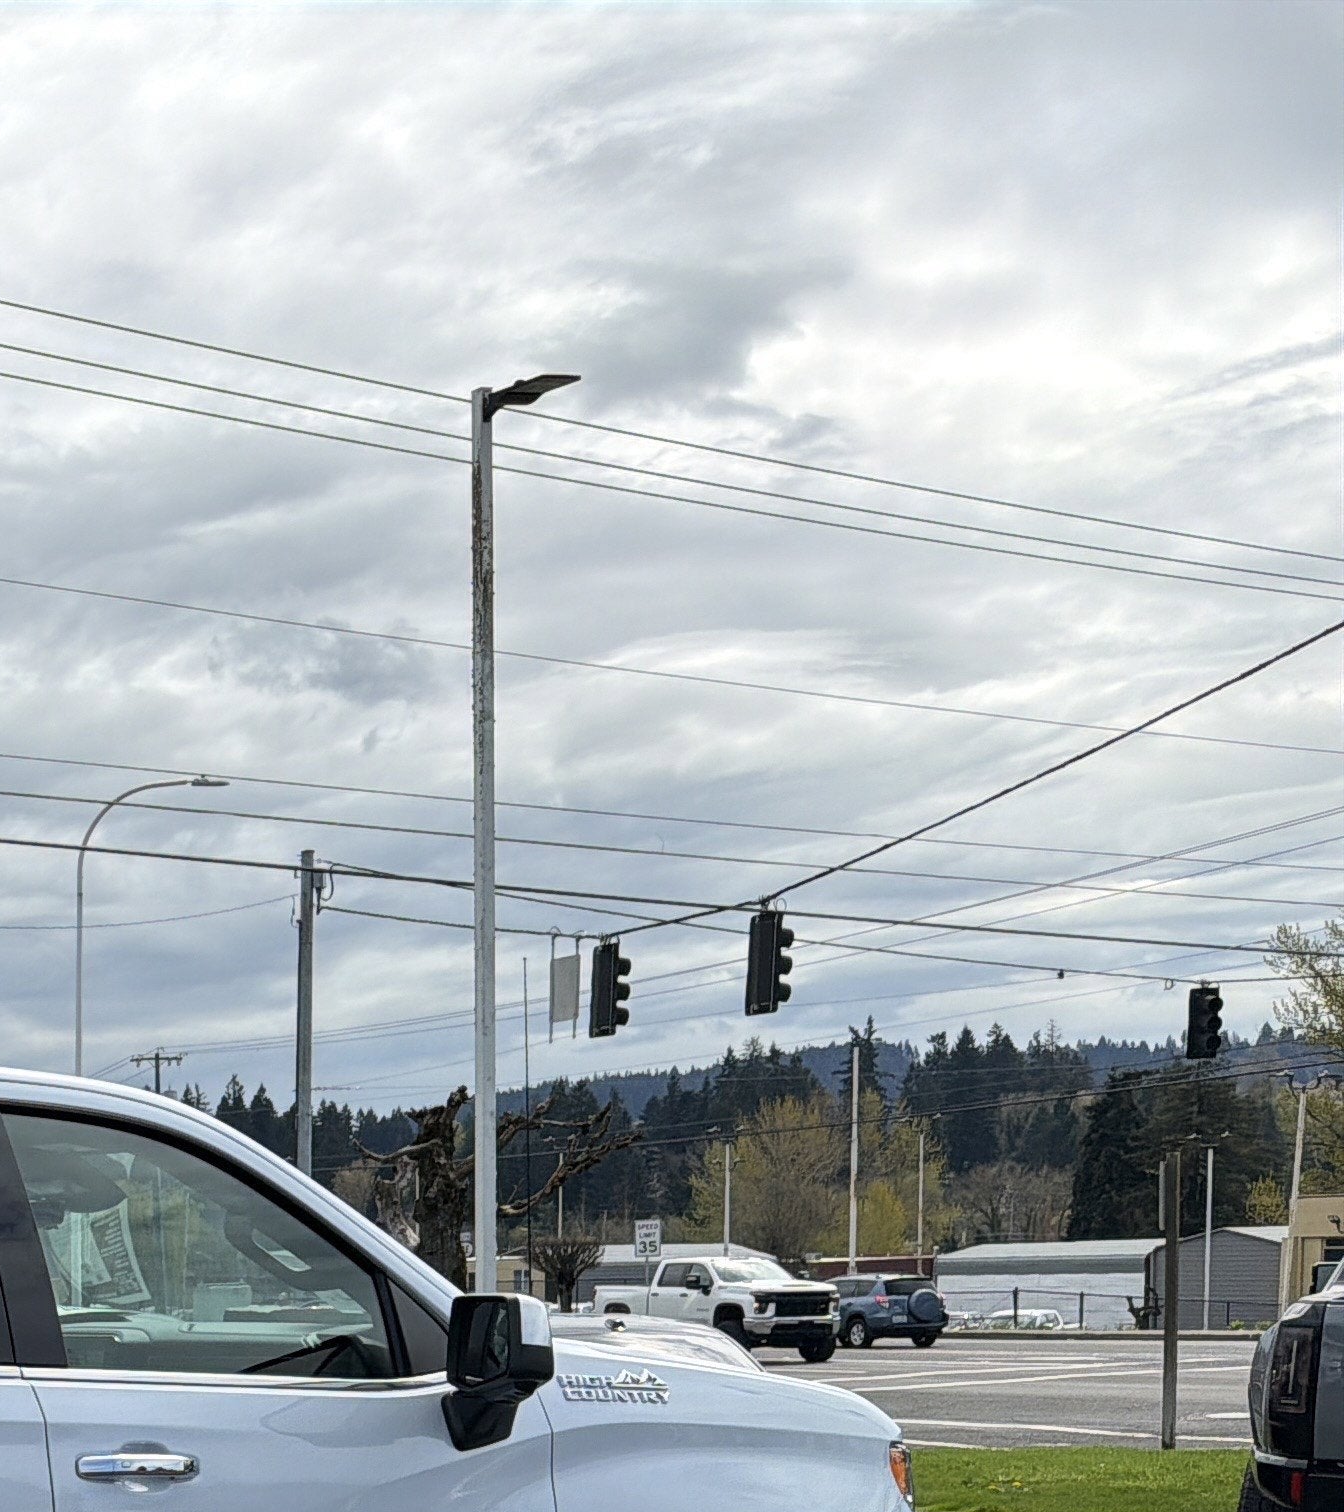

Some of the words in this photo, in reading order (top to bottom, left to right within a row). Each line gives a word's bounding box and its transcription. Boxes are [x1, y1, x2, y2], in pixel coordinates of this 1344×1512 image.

[639, 1240, 658, 1253] 35
[556, 1374, 615, 1388] HIGH
[563, 1386, 670, 1404] COUNTRY
